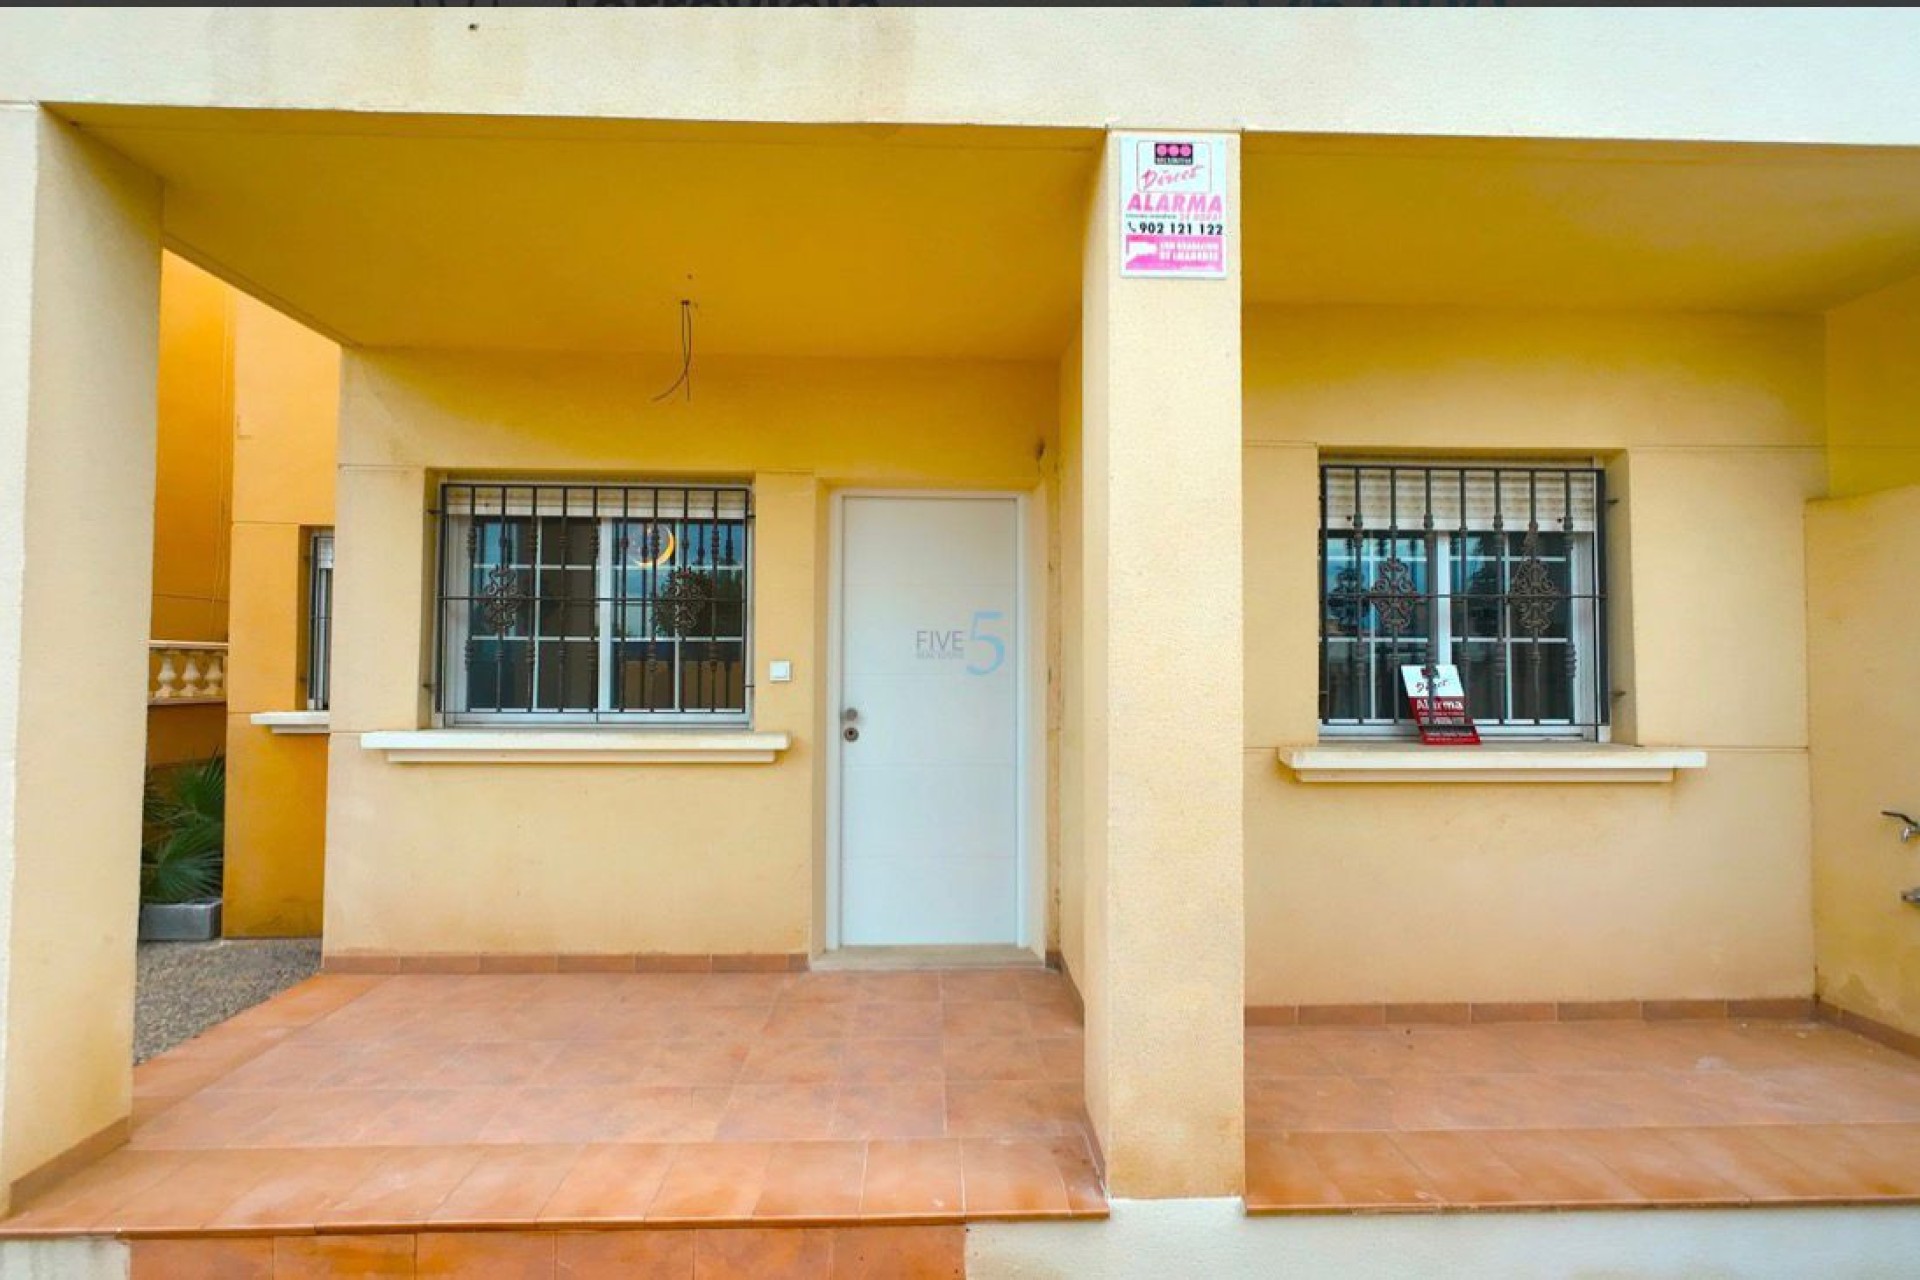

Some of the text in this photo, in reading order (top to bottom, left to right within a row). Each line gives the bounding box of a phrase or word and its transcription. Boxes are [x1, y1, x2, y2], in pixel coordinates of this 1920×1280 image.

[1127, 193, 1222, 212] ALARMA
[1139, 222, 1223, 235] 902 121 122
